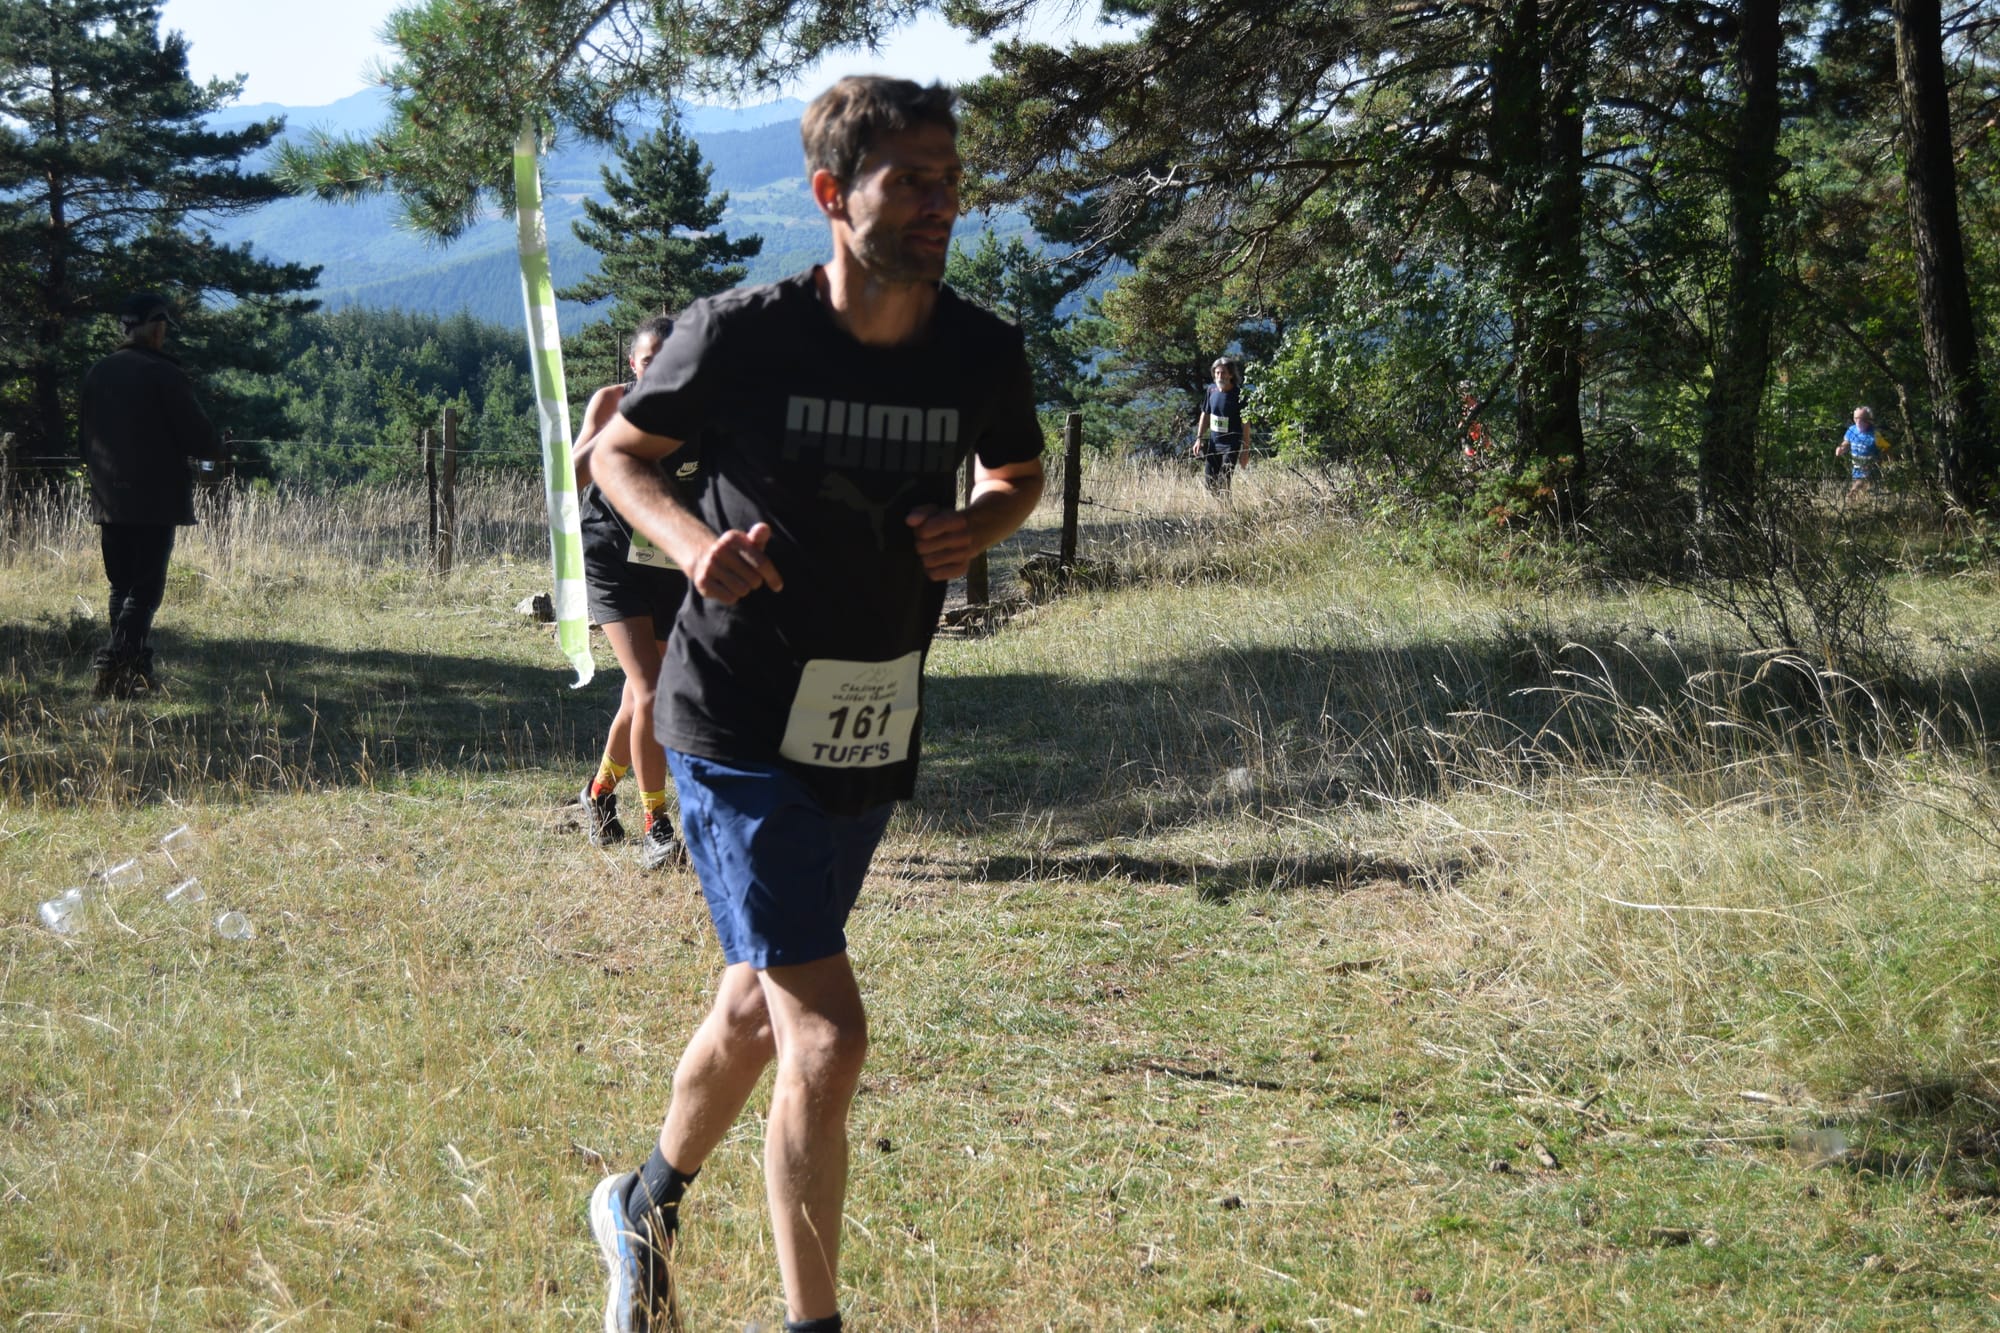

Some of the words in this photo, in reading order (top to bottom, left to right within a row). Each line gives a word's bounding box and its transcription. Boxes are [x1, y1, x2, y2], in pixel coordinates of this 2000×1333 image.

[782, 395, 959, 472] PUMA
[828, 703, 892, 739] 161
[812, 742, 890, 763] TUFF'S
